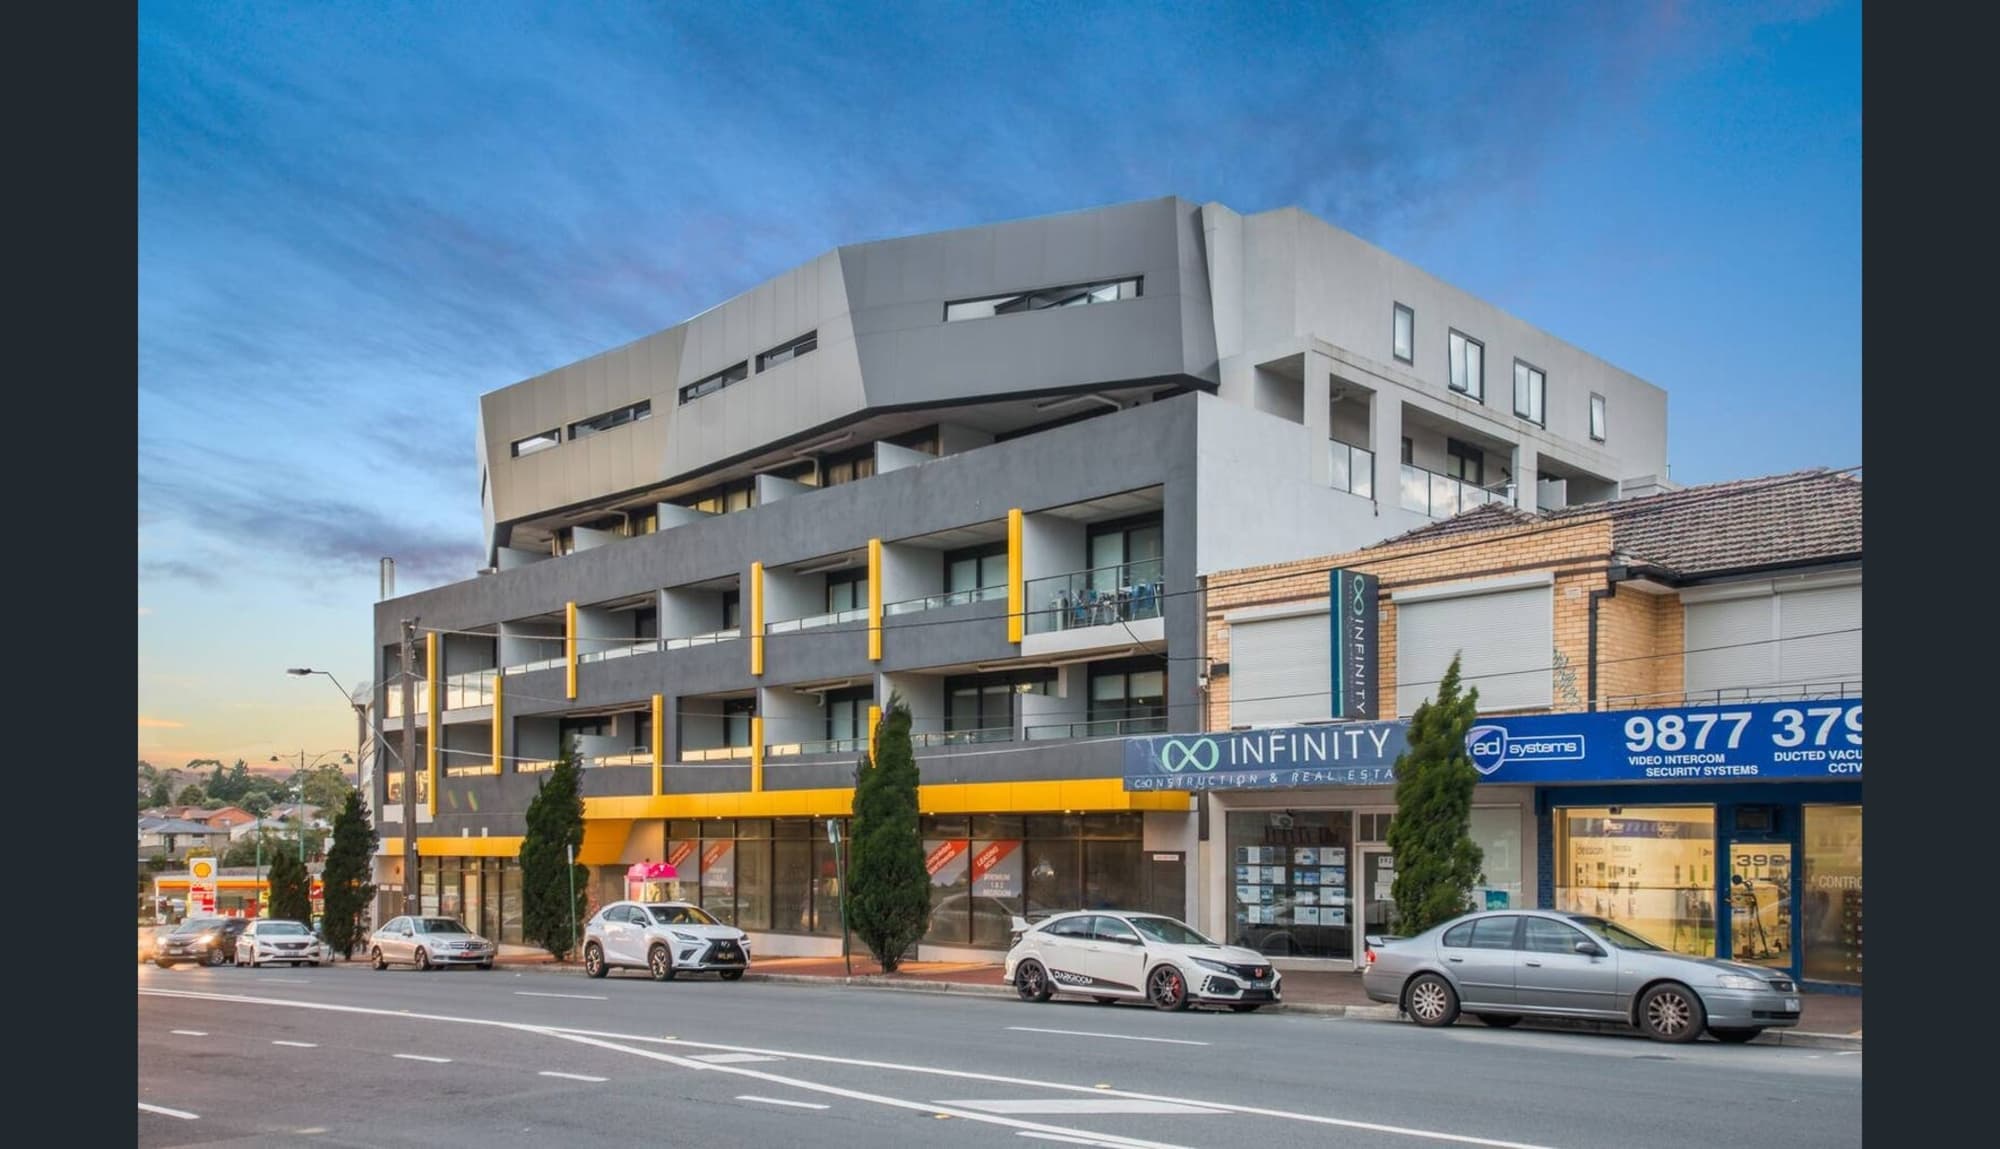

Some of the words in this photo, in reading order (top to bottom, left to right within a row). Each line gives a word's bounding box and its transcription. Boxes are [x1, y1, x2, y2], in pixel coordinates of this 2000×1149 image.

[1354, 618, 1366, 714] INFINITY
[1623, 711, 1752, 752] 9877
[1771, 704, 1862, 748] 379
[1230, 728, 1391, 765] INFINITY
[1473, 736, 1501, 756] ad
[1509, 741, 1577, 757] systems
[1773, 750, 1826, 762] DUCTED
[1828, 749, 1862, 760] VACU
[1628, 755, 1662, 766] VIDEO
[1665, 753, 1725, 765] INTERCOM
[1828, 762, 1862, 773] CCTV
[1134, 774, 1258, 789] CONSTRUCTION
[1269, 773, 1278, 783] &
[1291, 770, 1335, 783] REAL
[1646, 766, 1701, 777] SECURITY
[1703, 764, 1758, 776] SYSTEMS
